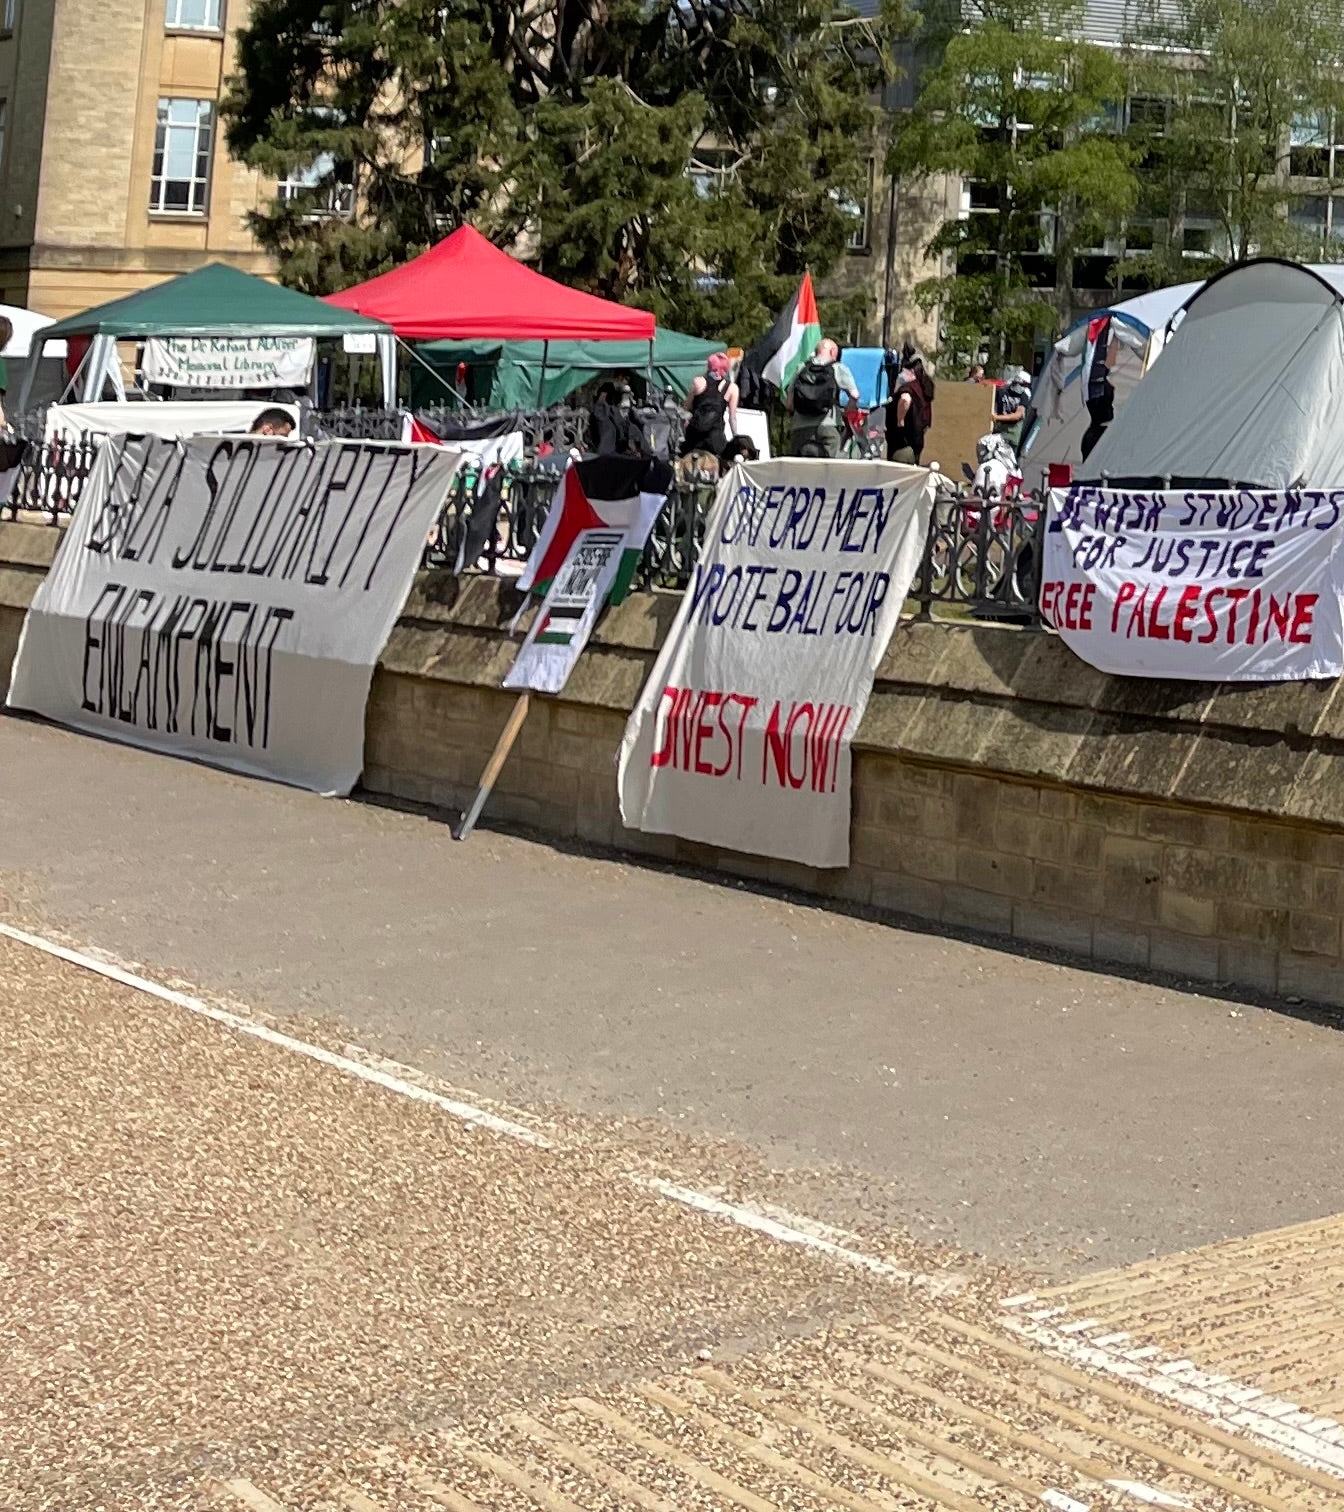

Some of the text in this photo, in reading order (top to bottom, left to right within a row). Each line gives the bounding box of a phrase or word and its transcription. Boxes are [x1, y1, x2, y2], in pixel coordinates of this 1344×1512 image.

[172, 439, 439, 591] SOLIDARITY
[721, 486, 899, 554] OXFORD MEN
[1048, 485, 1344, 533] JEWISH STUDENTS
[1073, 535, 1276, 578] FOR JUSTICE
[767, 569, 890, 636] BALFOUR
[1041, 580, 1319, 645] FREE PALESTINE
[81, 583, 294, 749] ENCAMPMENT
[651, 685, 852, 793] DIVEST NOW!
